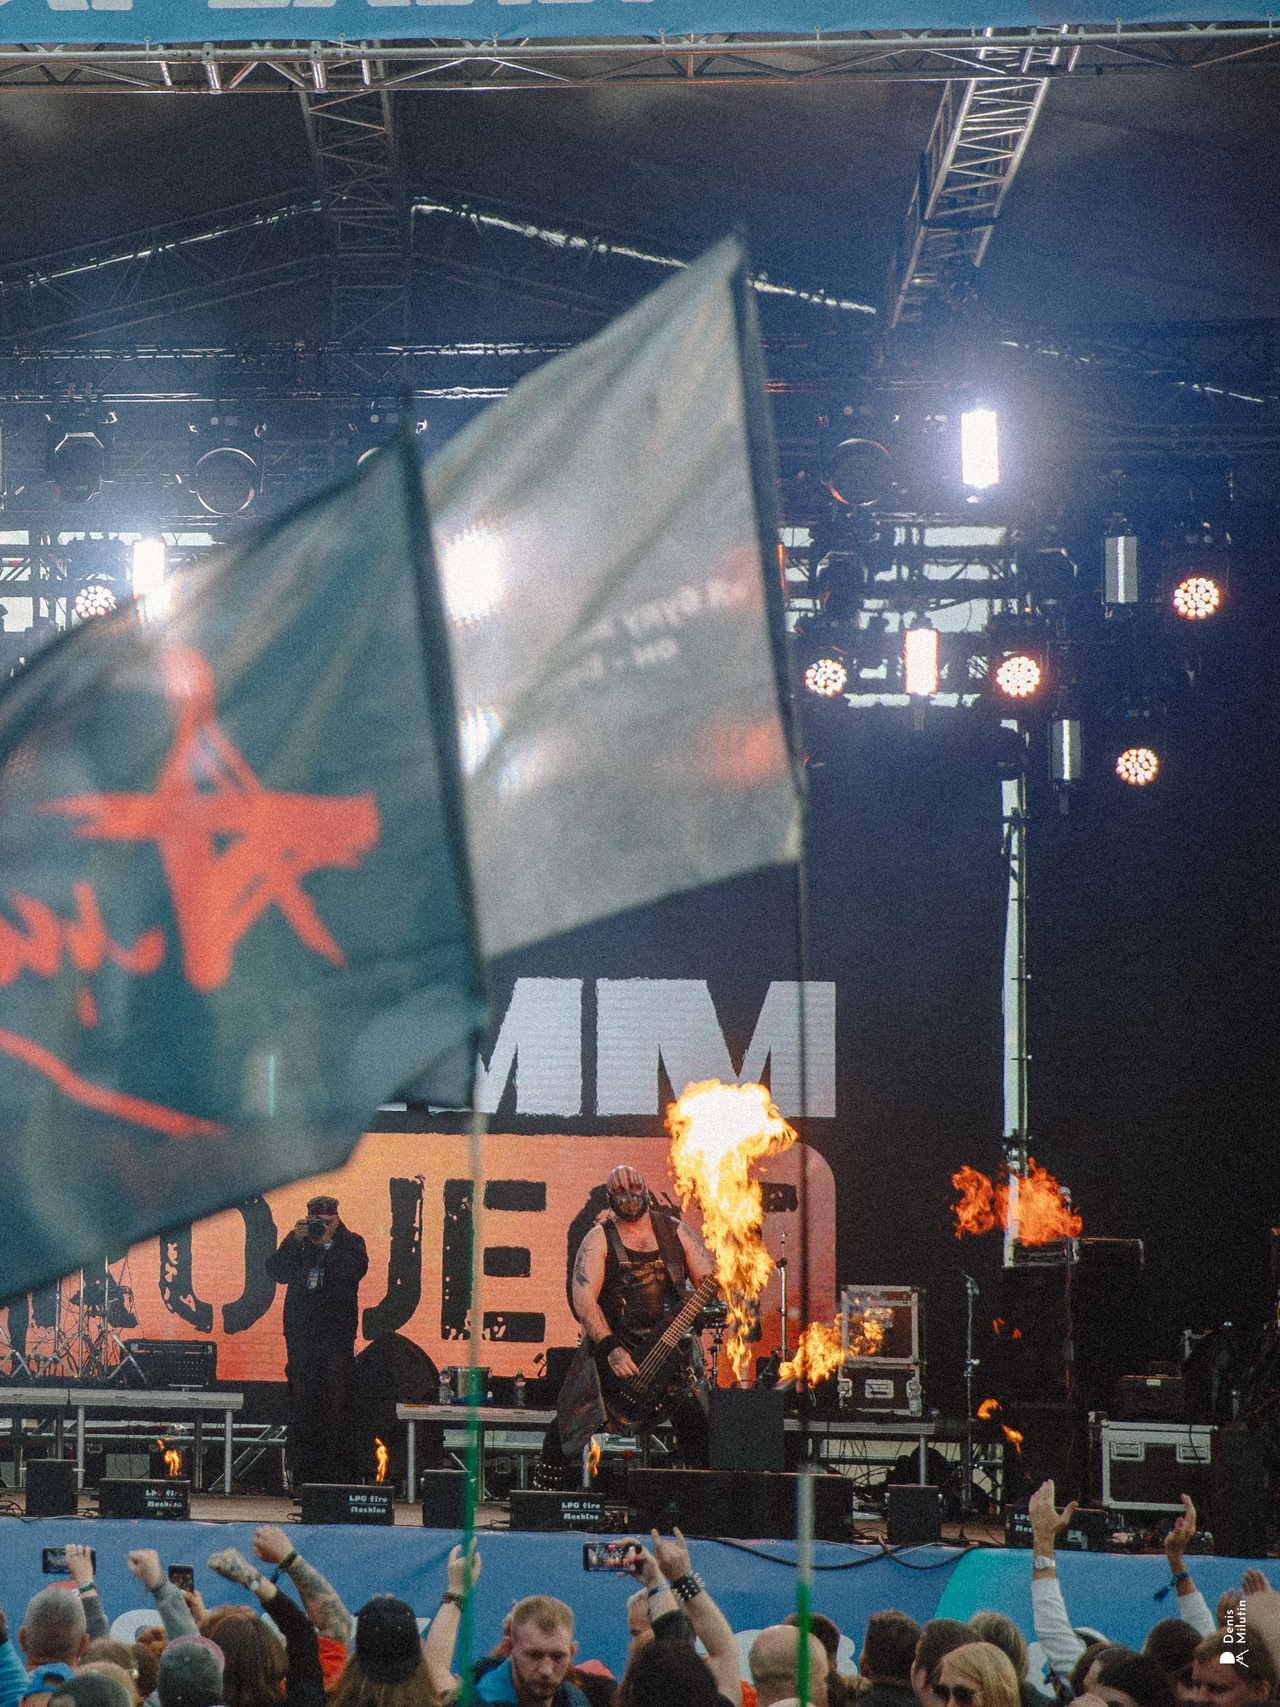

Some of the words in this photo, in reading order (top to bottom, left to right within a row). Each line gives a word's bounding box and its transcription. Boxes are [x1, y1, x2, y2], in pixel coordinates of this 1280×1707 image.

[369, 1495, 388, 1503] fire
[561, 1501, 580, 1509] LPG
[582, 1501, 601, 1509] fire
